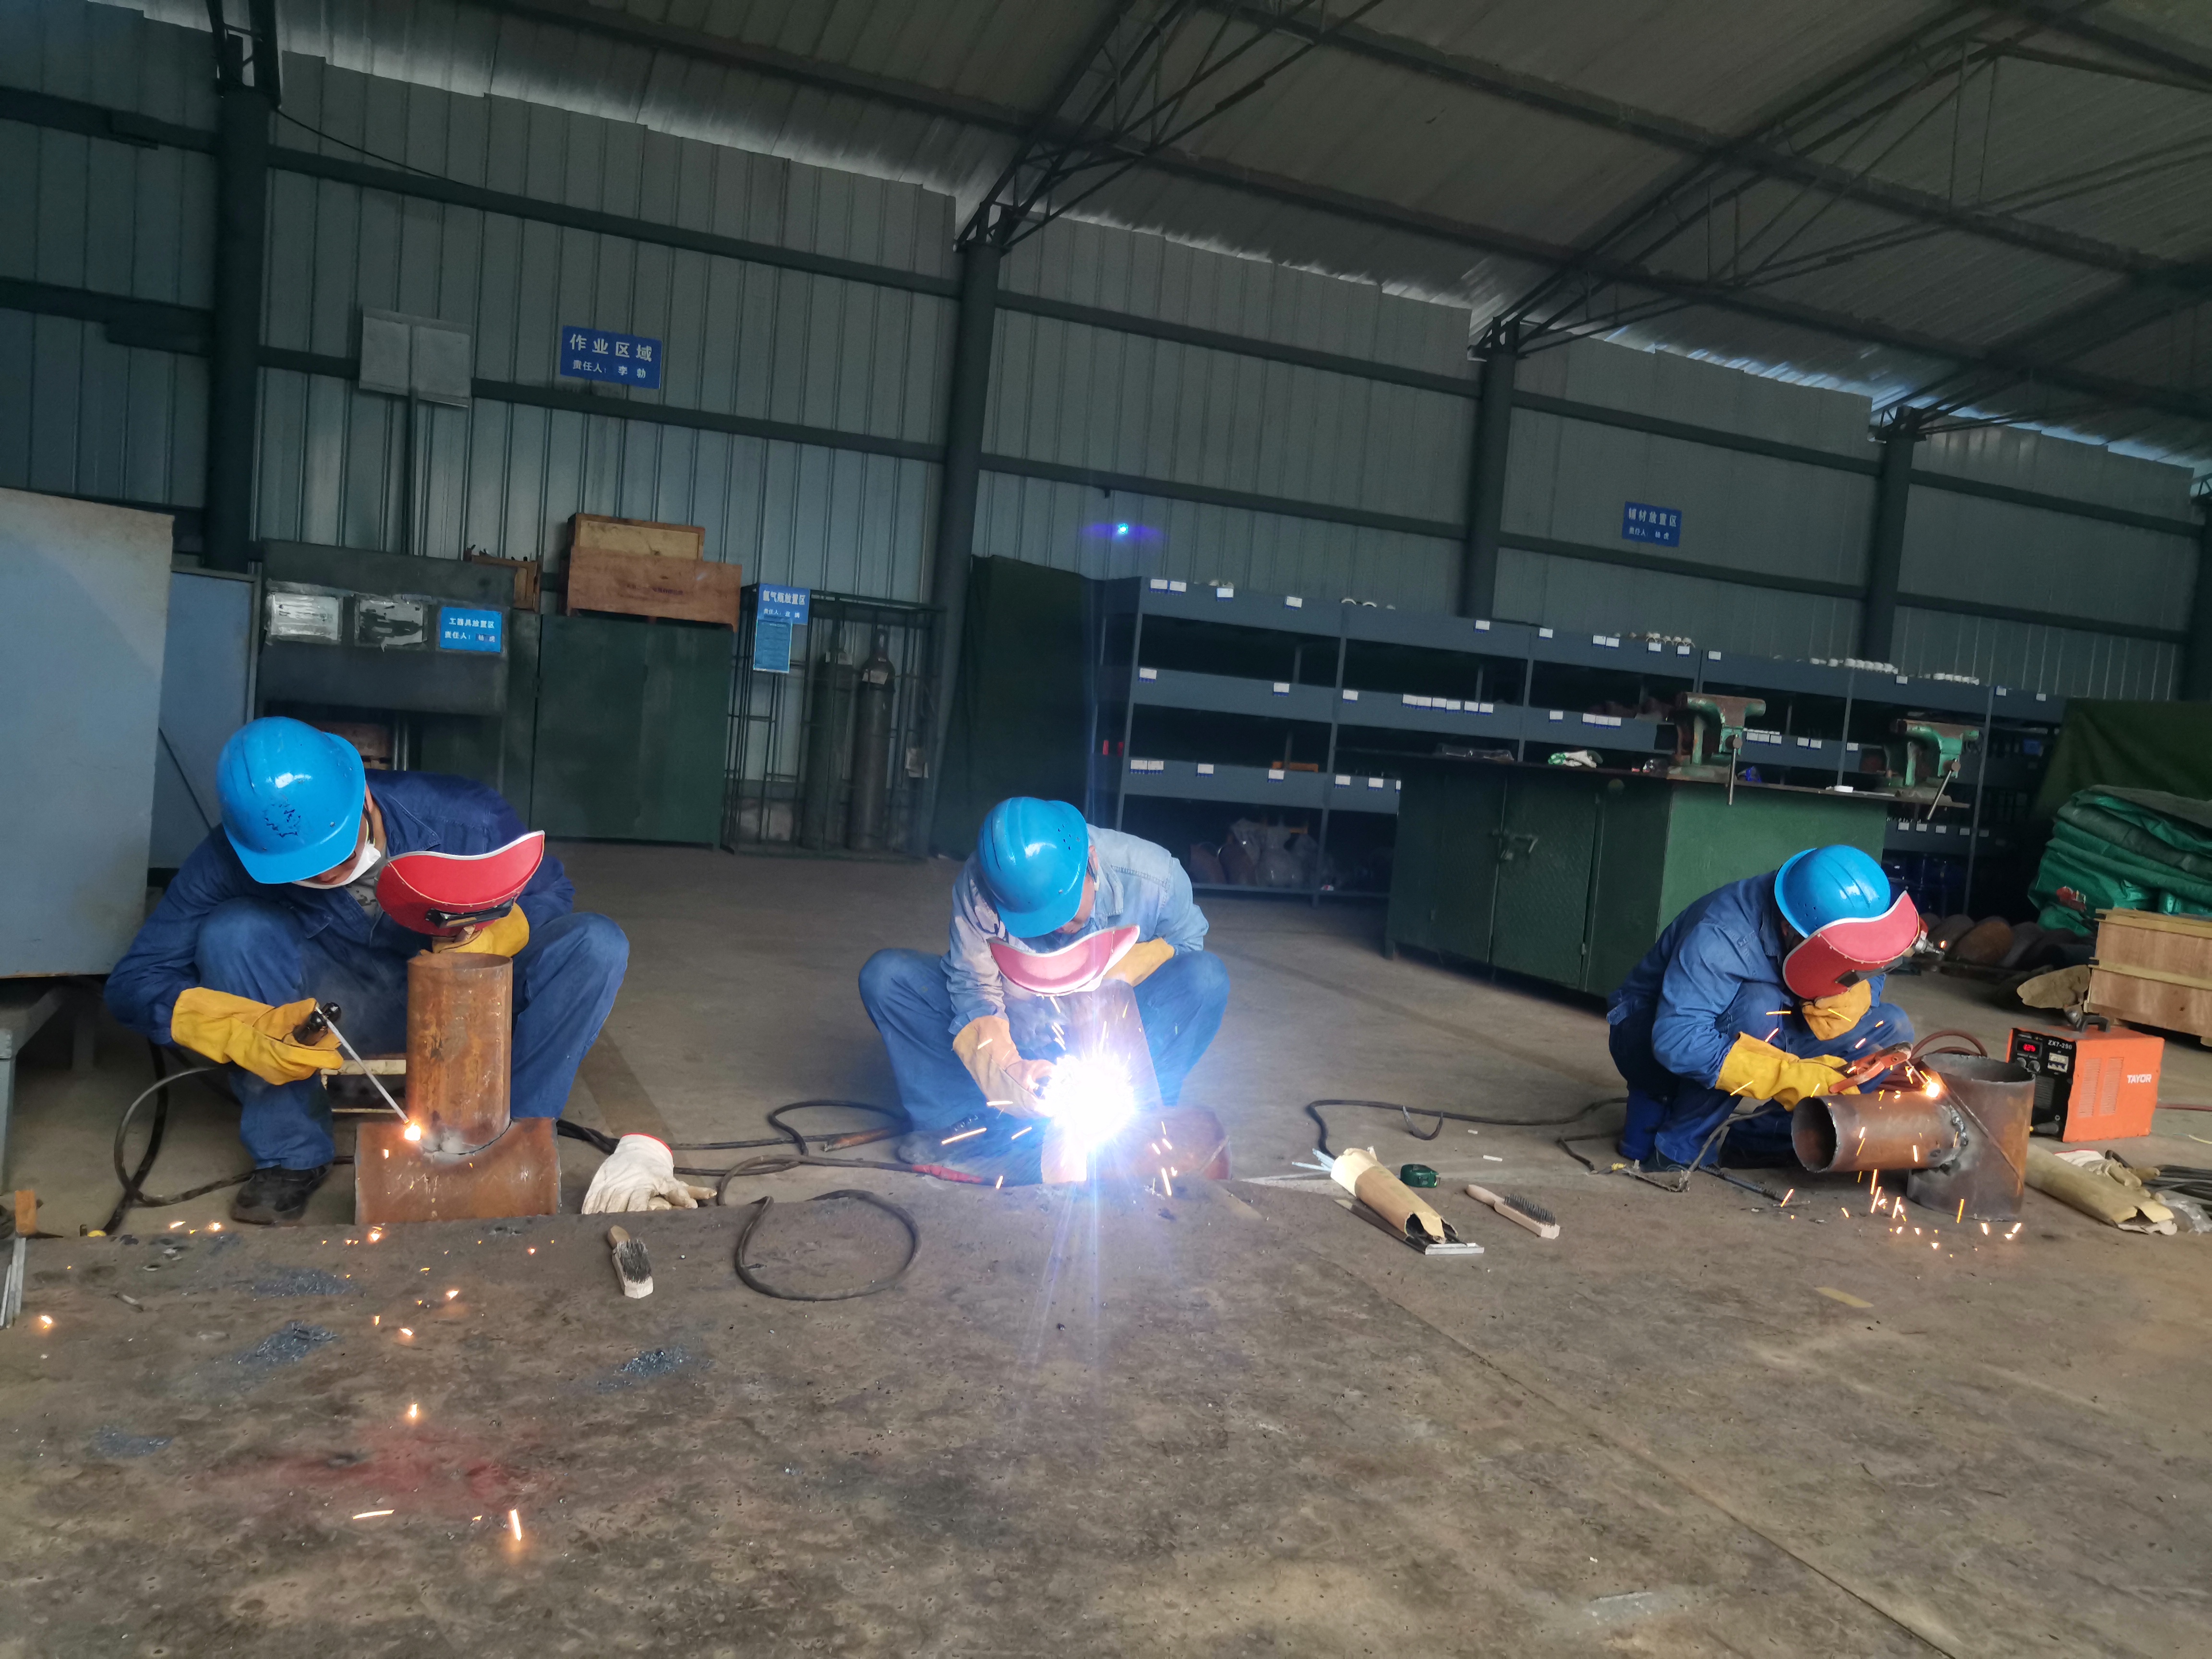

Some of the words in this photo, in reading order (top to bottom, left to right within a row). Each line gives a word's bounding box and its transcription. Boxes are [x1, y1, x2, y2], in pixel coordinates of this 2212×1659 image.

[570, 333, 652, 362] 作业区域
[2127, 1074, 2152, 1083] TAYOR
